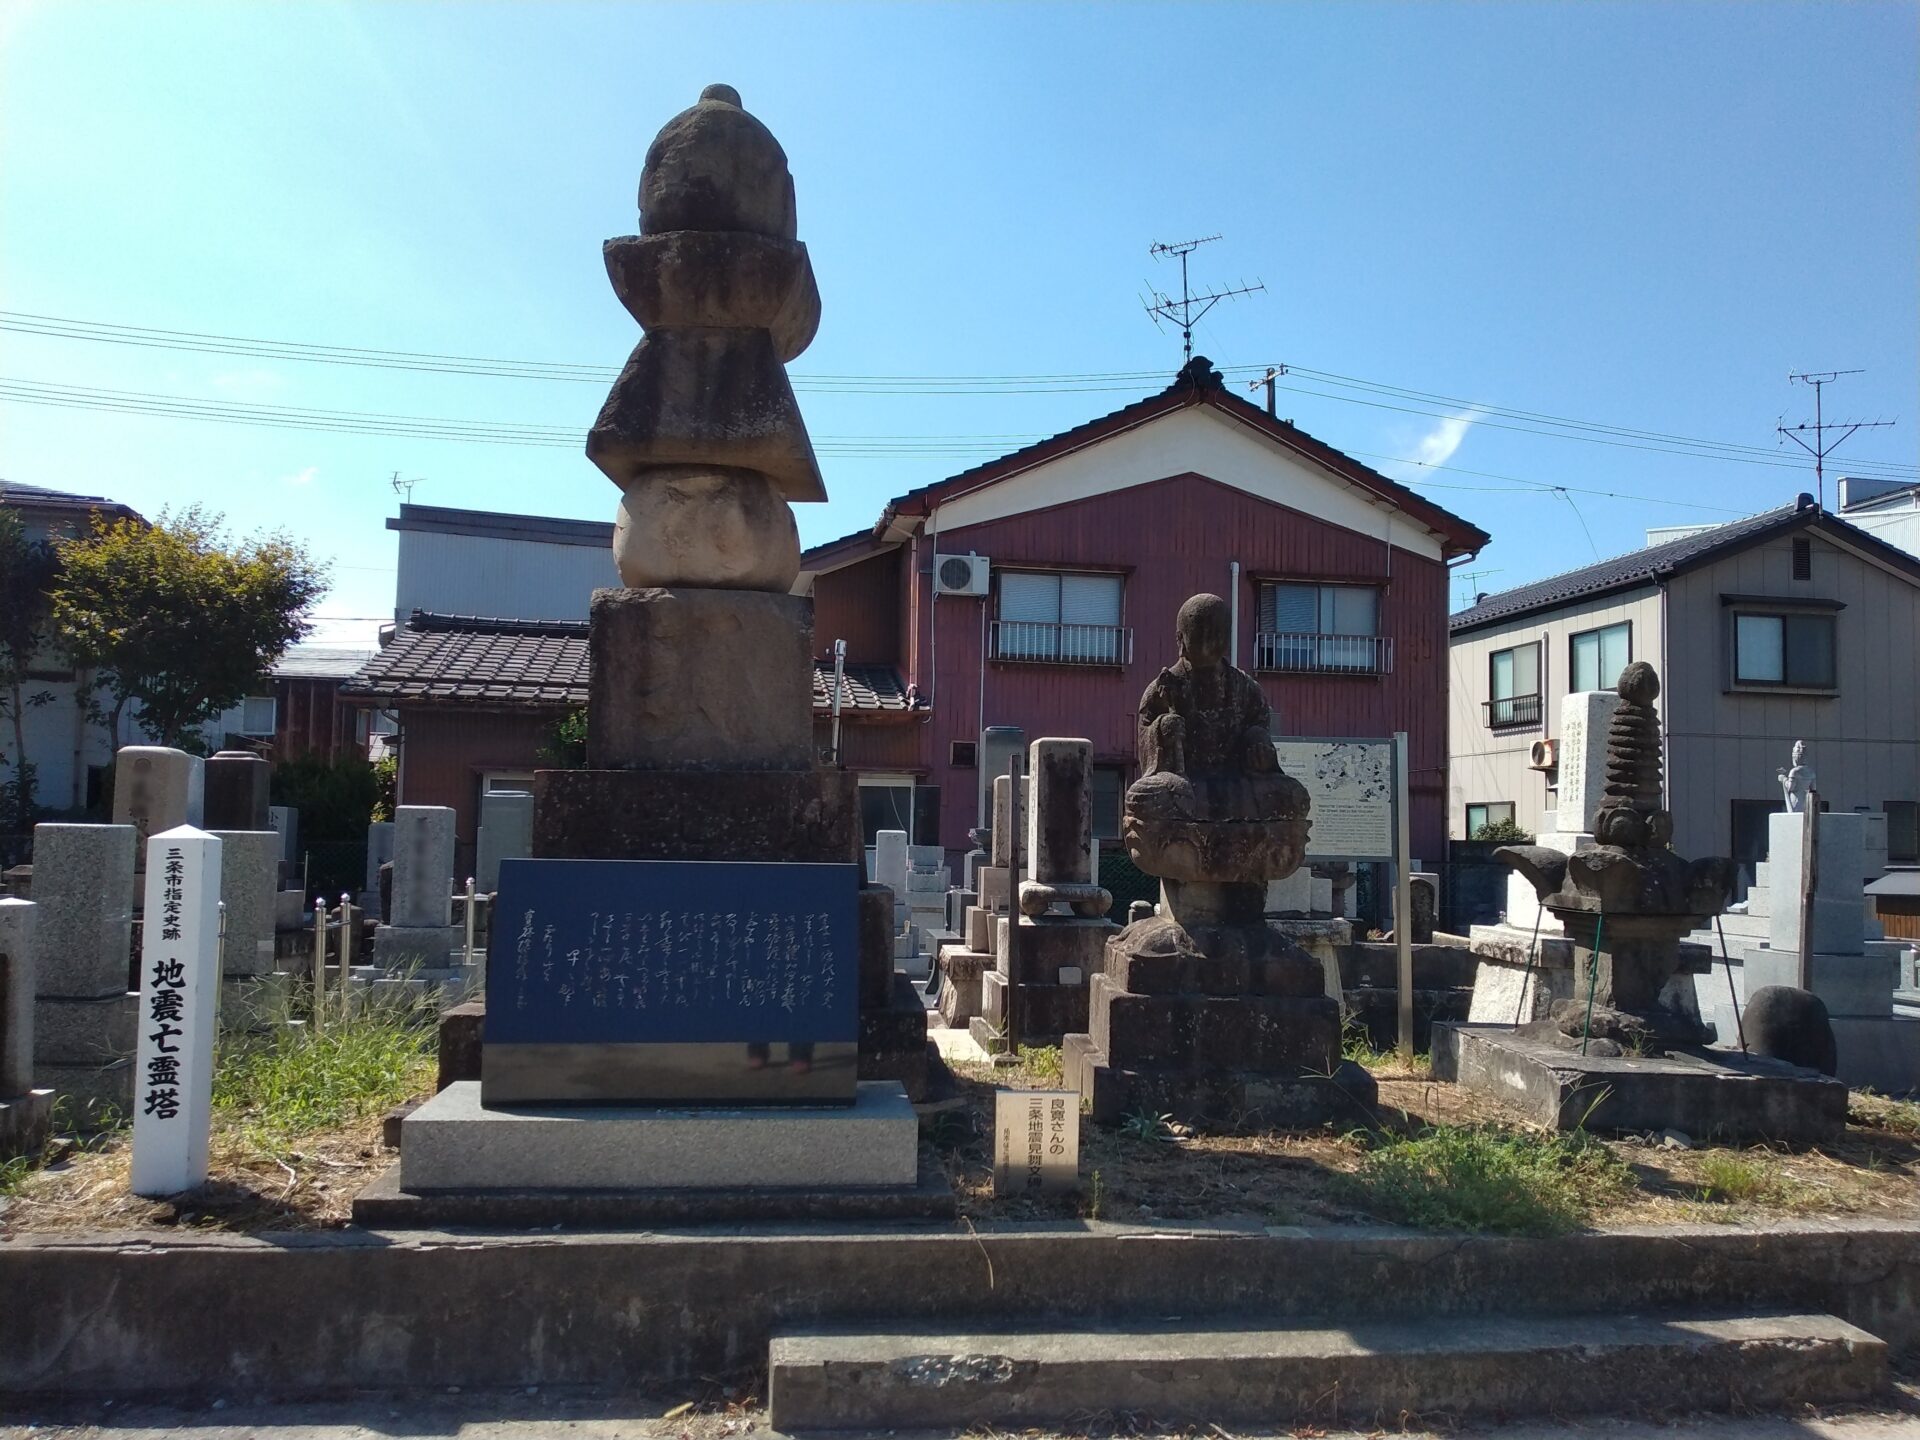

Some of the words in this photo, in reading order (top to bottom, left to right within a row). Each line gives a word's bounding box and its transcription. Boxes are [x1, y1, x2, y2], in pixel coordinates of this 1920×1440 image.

[162, 848, 184, 940] 三条市指定史跡
[144, 958, 187, 1120] 地震亡霊塔
